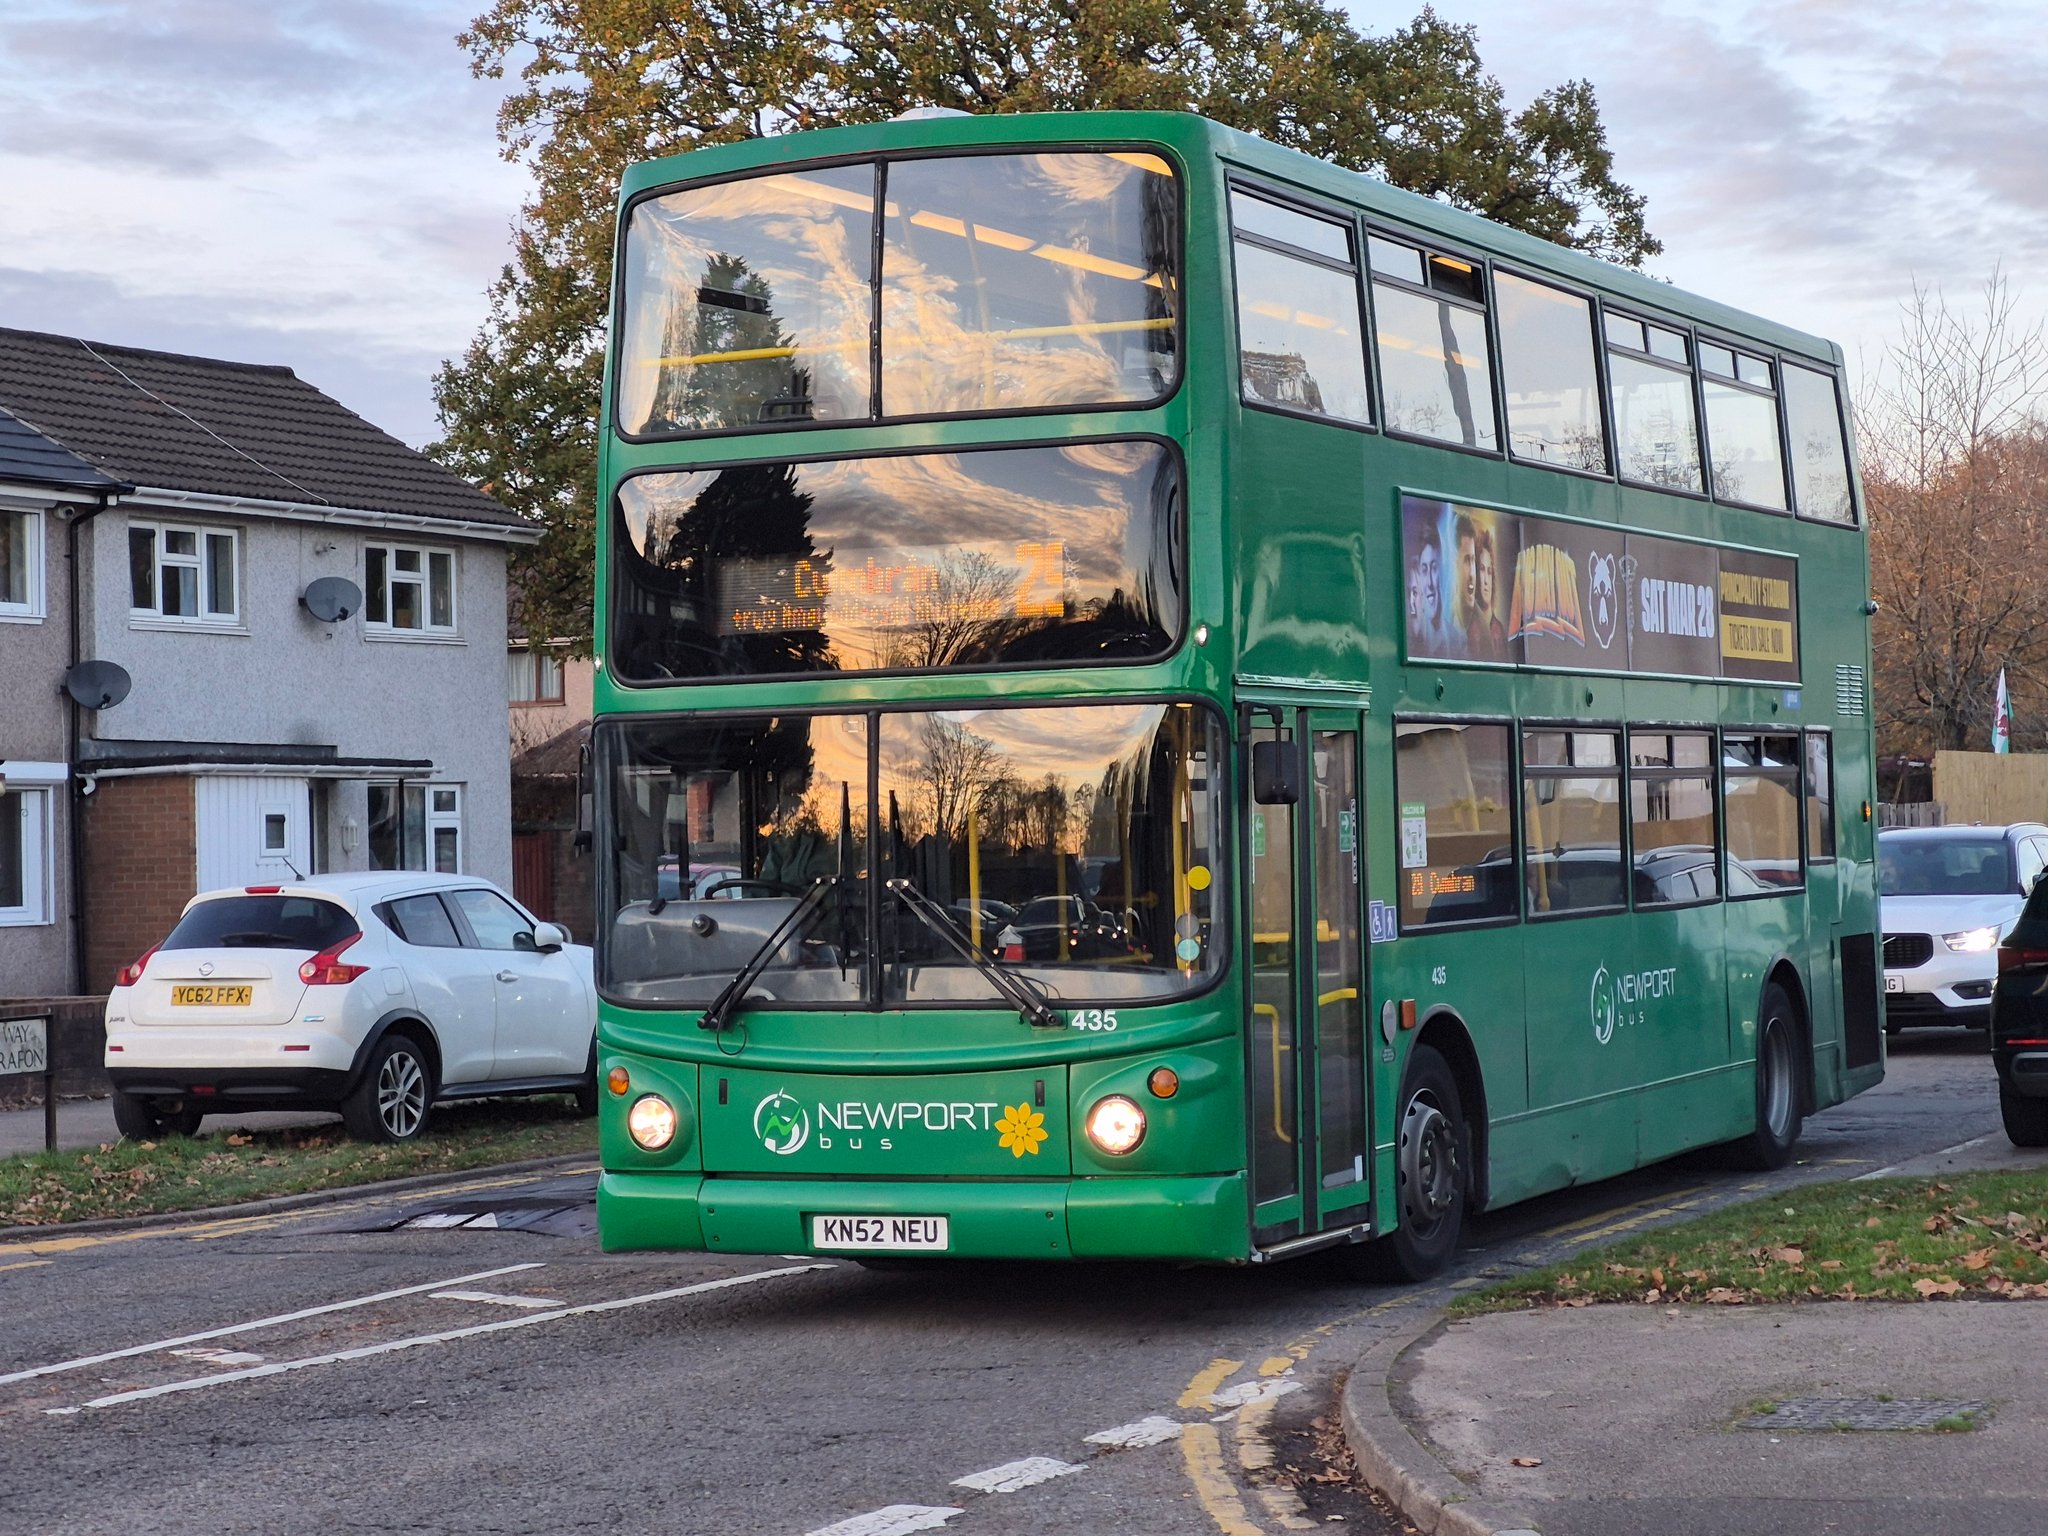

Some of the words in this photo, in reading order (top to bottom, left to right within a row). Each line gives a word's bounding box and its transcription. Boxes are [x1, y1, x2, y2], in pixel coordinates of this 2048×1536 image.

[1641, 577, 1665, 633] SAT
[1667, 581, 1697, 637] MAR
[1697, 585, 1715, 638] 28
[1432, 967, 1447, 986] 435
[1617, 967, 1677, 1004] NEWPORT
[178, 987, 213, 1003] YC62
[217, 987, 246, 1003] FFX
[1071, 1010, 1118, 1032] 435
[1618, 1010, 1645, 1028] bus
[3, 1025, 30, 1043] WAY
[818, 1102, 998, 1131] NEWPORT
[819, 1134, 893, 1150] bus
[823, 1219, 885, 1244] KN52
[892, 1219, 939, 1244] NEU
